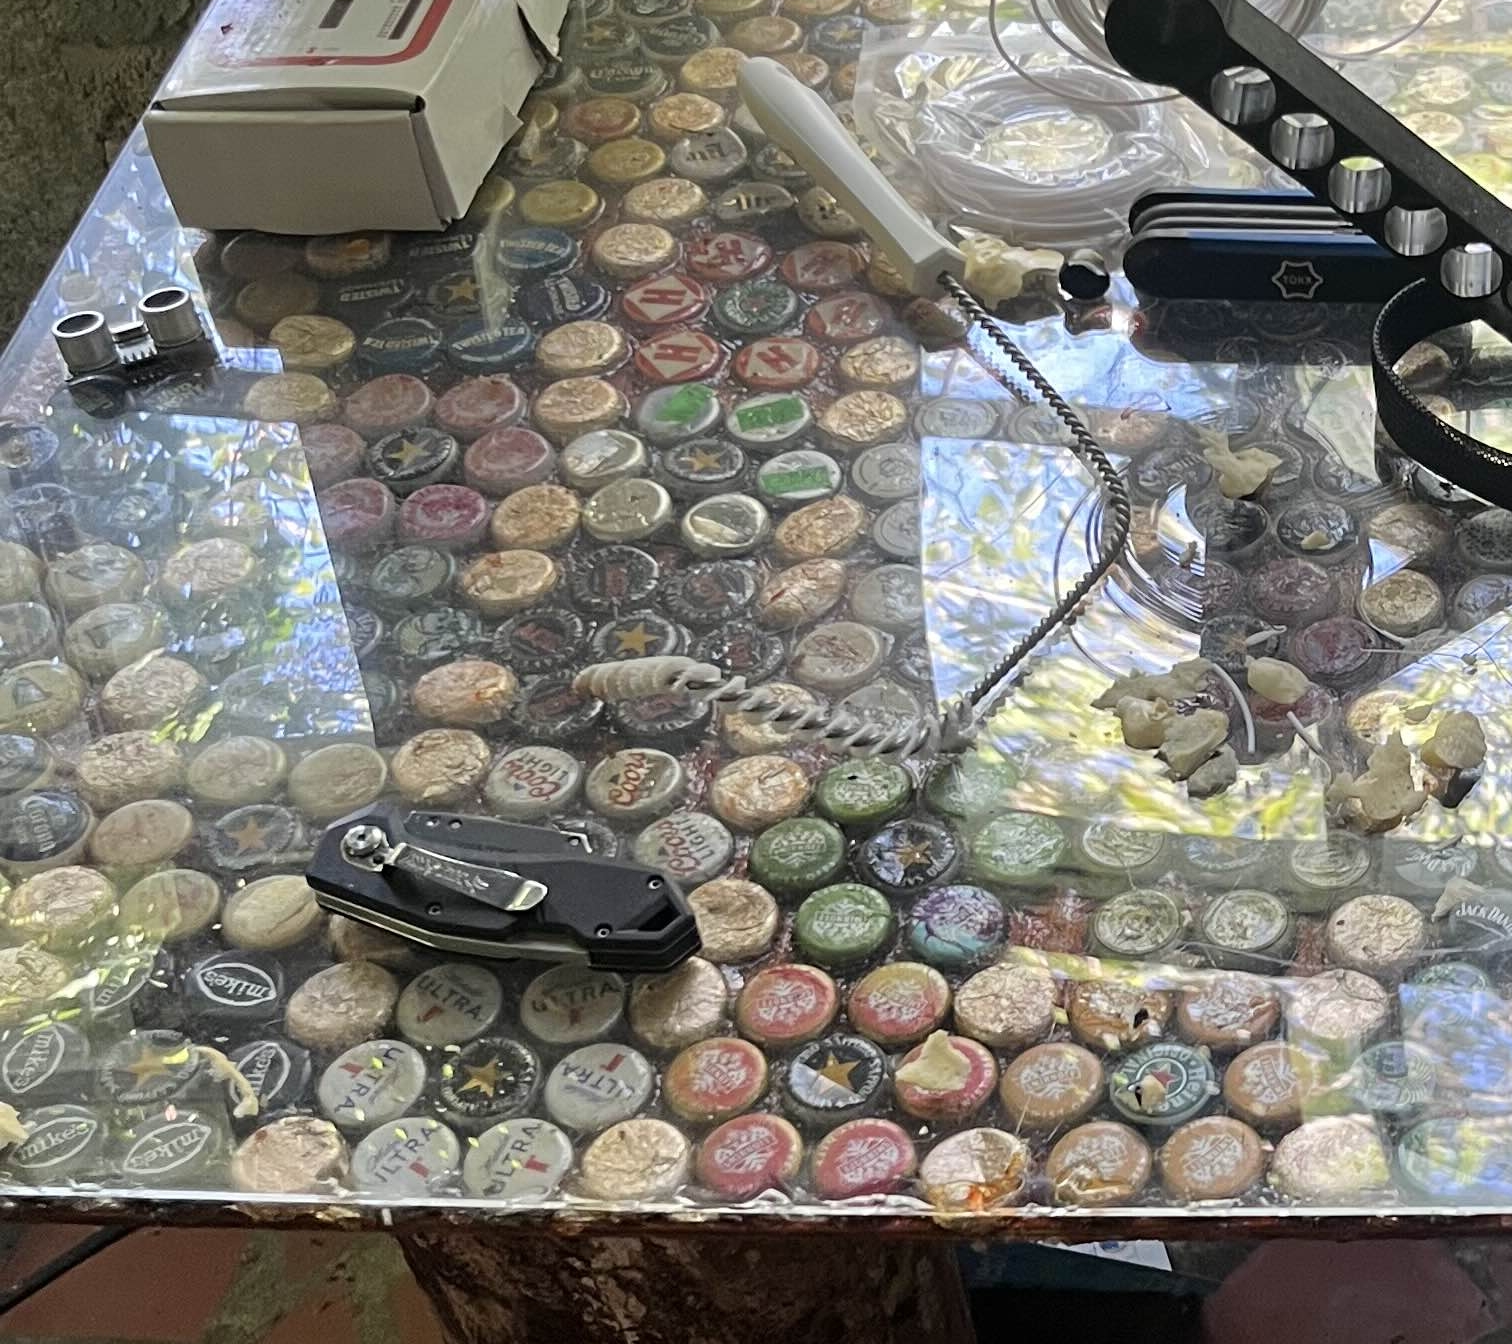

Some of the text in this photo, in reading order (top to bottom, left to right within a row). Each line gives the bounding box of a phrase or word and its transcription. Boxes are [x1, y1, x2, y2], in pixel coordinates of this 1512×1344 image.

[201, 970, 275, 1002] mike's
[416, 974, 484, 1022] ULTRA
[14, 1031, 56, 1091] mike's
[18, 1120, 91, 1161] mike's
[129, 1127, 202, 1169] mike's
